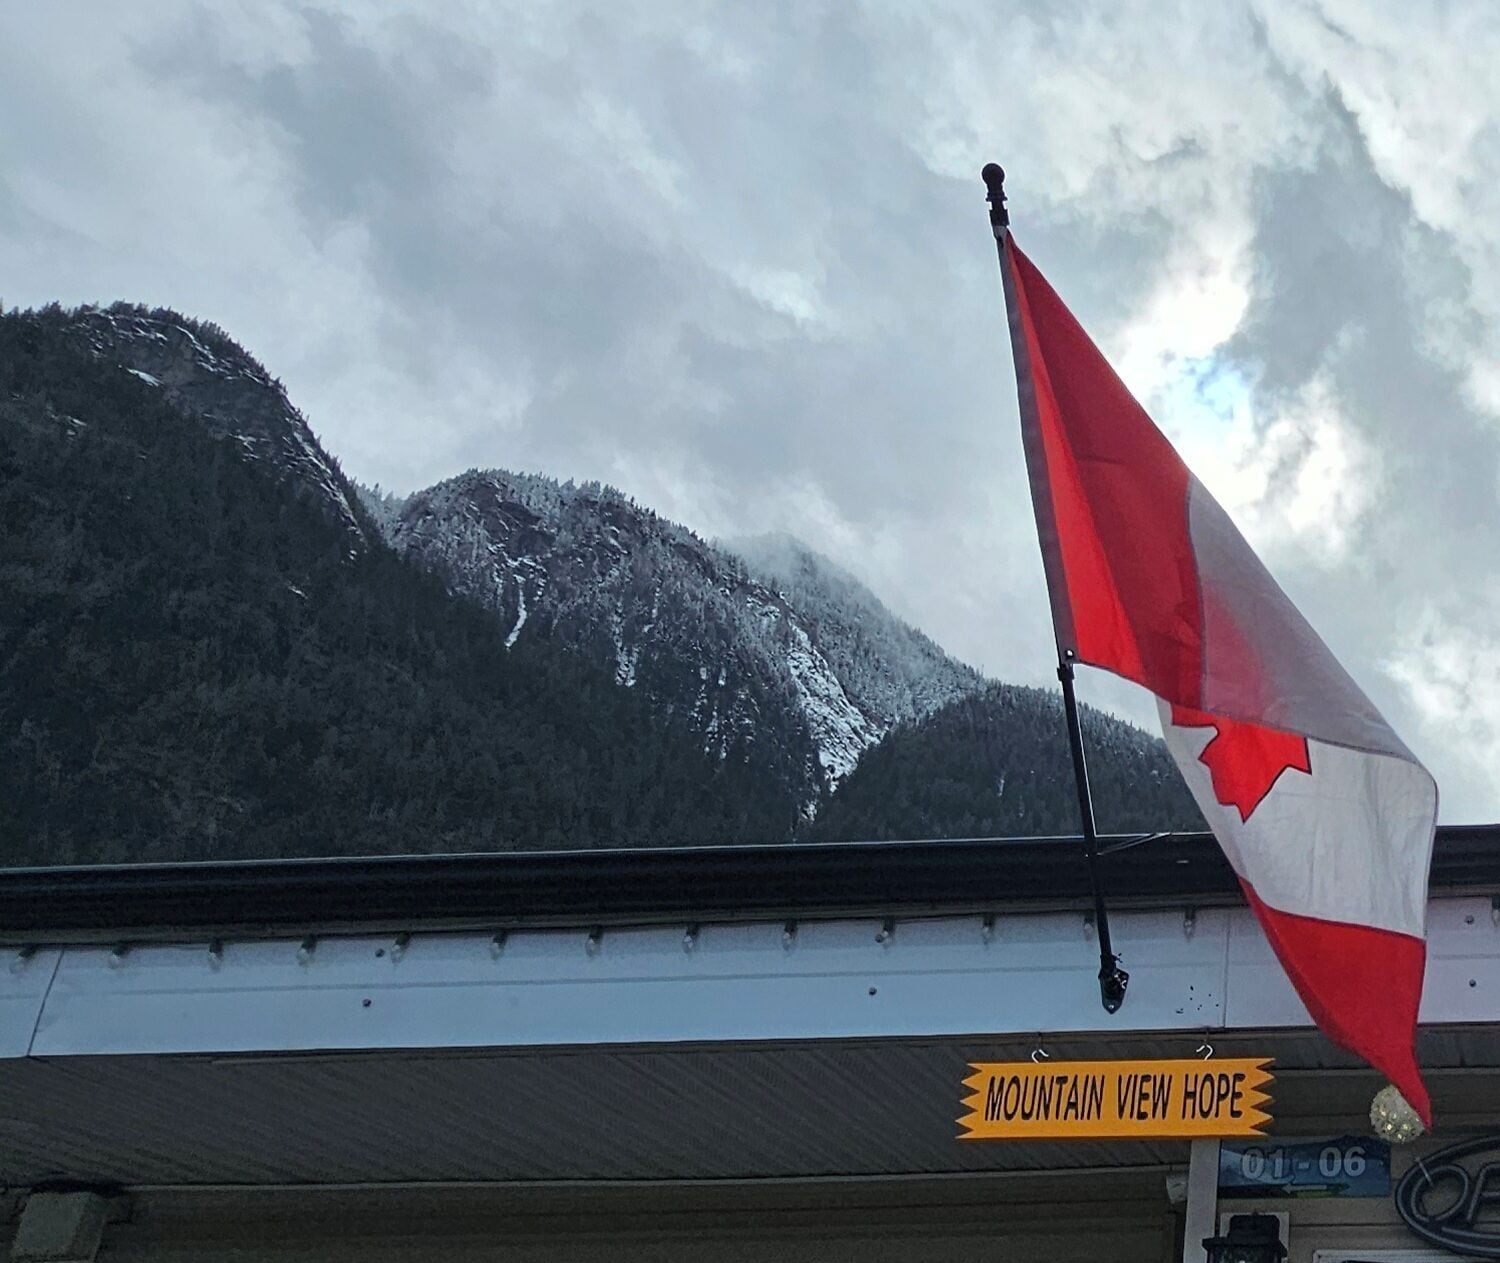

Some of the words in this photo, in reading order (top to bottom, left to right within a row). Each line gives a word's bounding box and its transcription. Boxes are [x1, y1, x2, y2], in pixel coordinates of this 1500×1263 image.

[984, 1075, 1105, 1121] MOUNTAIN
[1117, 1073, 1172, 1120] VIEW
[1181, 1073, 1246, 1119] HOPE
[1242, 1146, 1284, 1179] 01
[1319, 1146, 1366, 1177] 06
